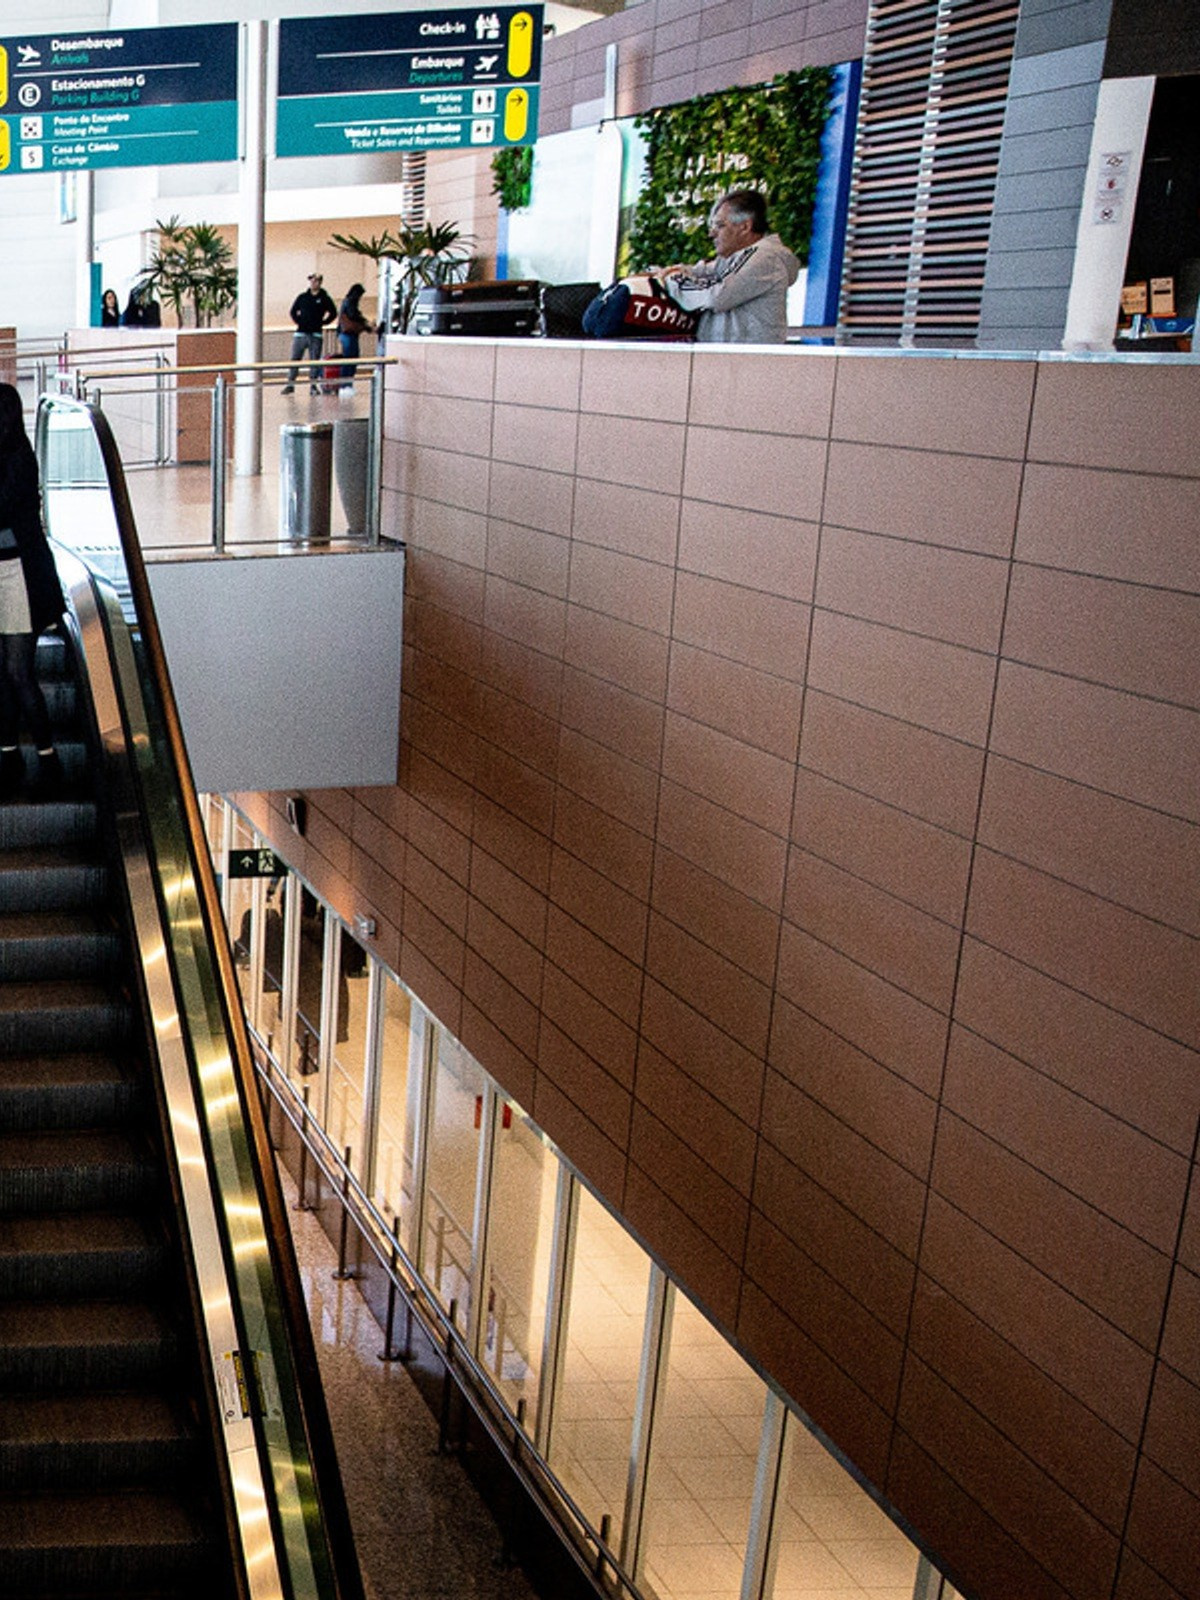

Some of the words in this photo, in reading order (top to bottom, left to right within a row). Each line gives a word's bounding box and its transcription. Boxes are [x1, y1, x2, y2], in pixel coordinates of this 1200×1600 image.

[419, 22, 466, 36] Check-in
[51, 37, 124, 51] Desembarque
[51, 53, 90, 65] Arrivals
[411, 55, 465, 69] Embarque
[51, 76, 135, 91] Estacionamento
[136, 74, 146, 87] G
[408, 71, 463, 84] Departures
[52, 92, 88, 106] Parking
[90, 90, 129, 103] Building
[53, 116, 78, 126] Ponto
[80, 114, 90, 124] de
